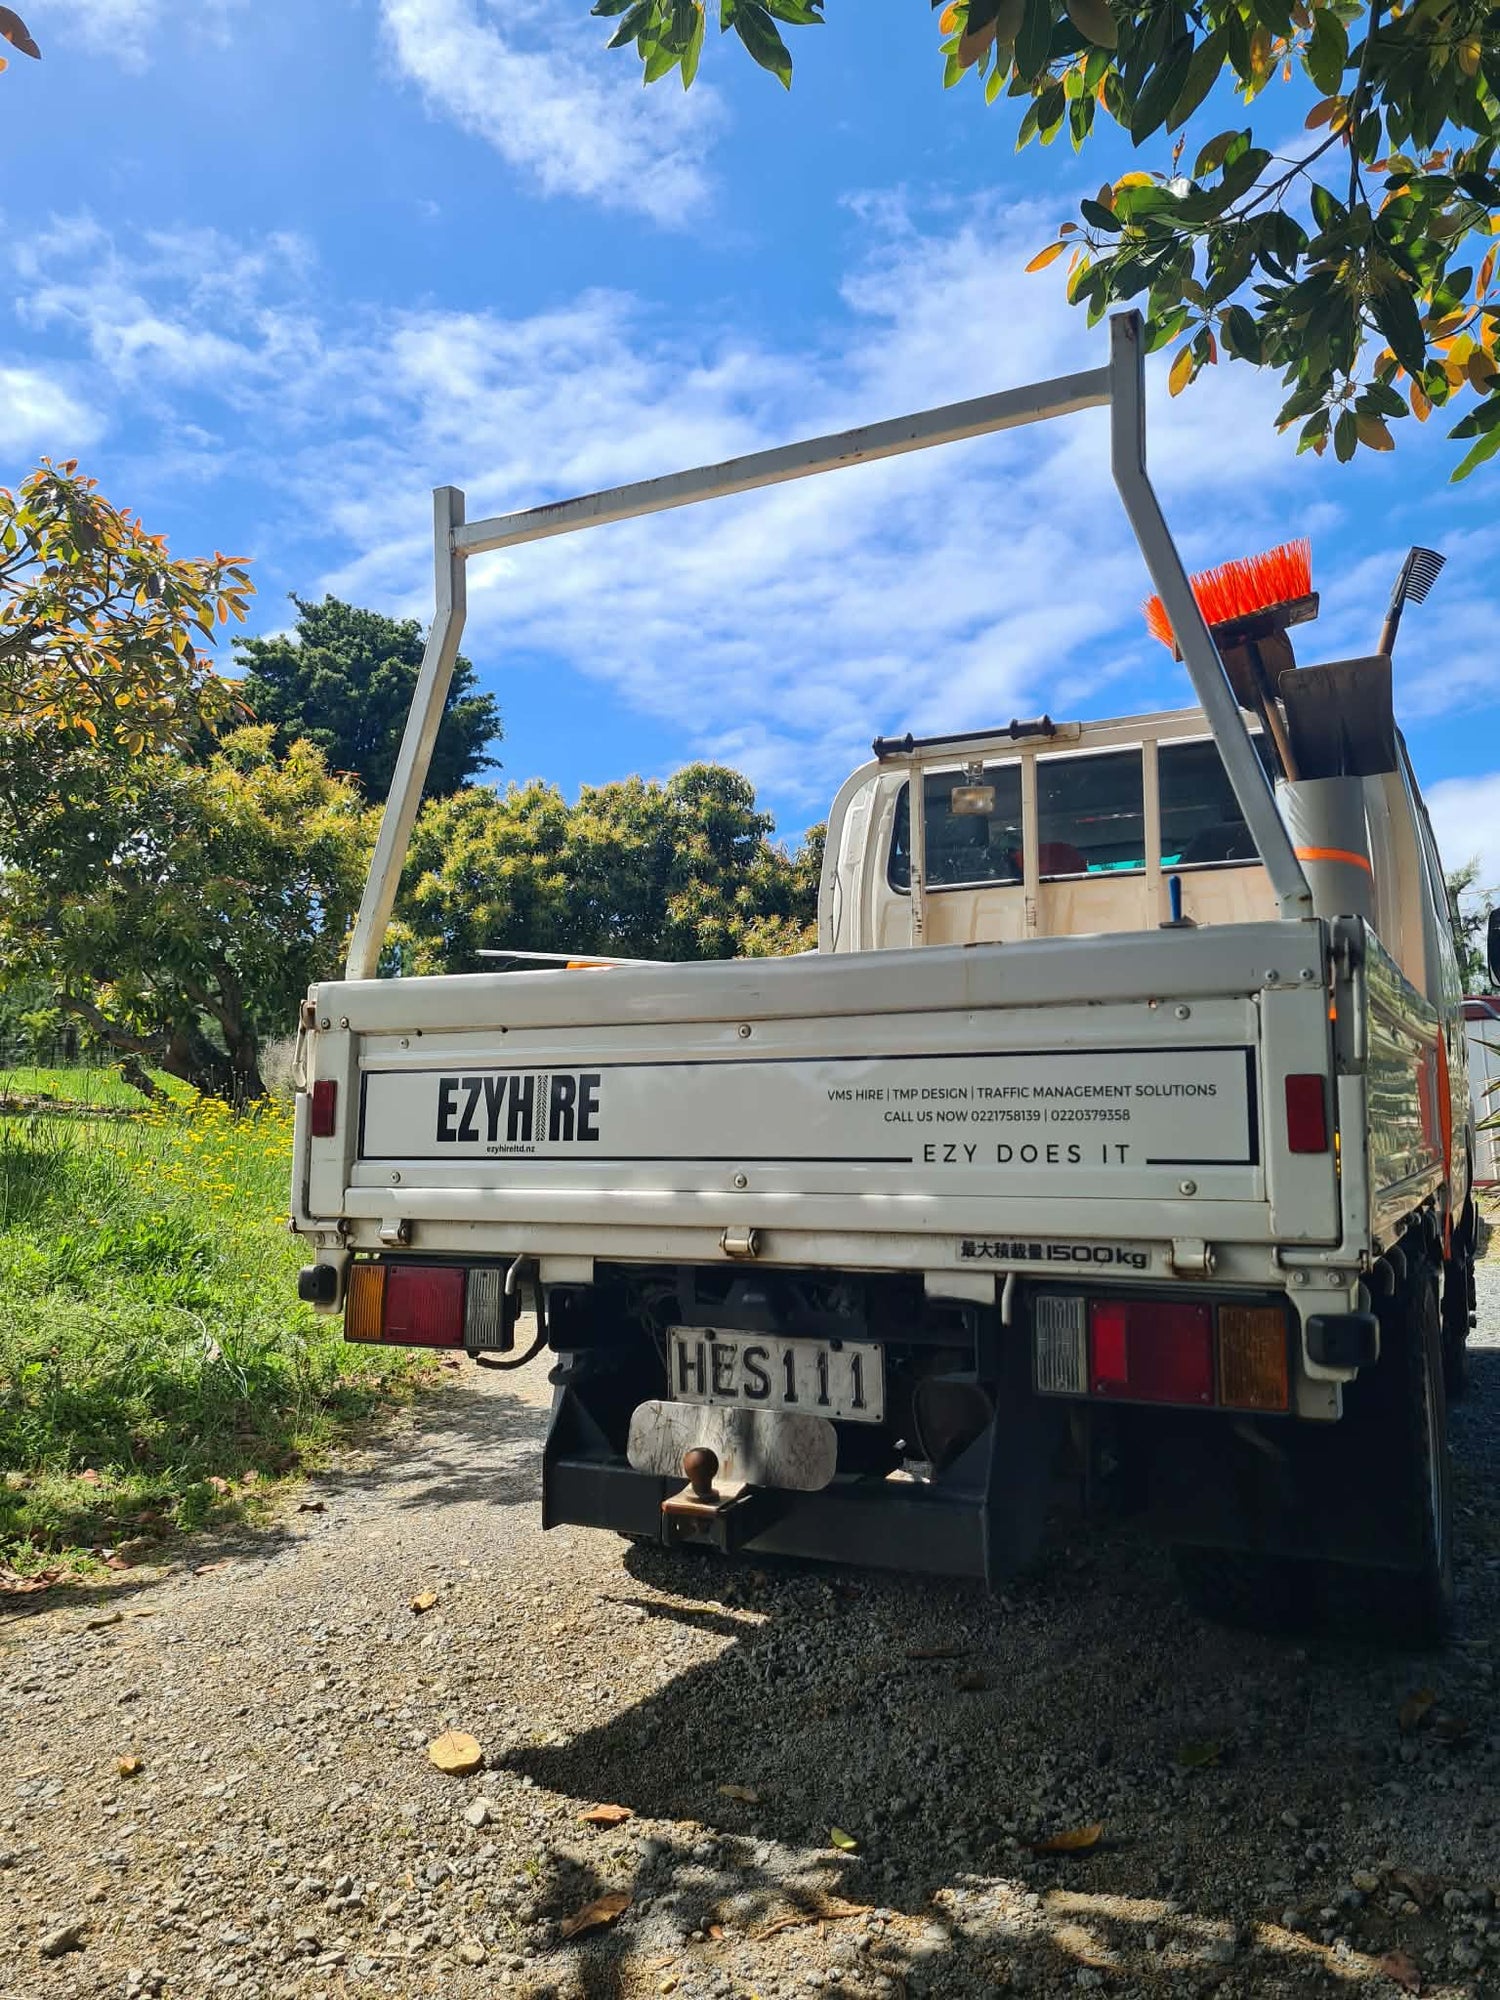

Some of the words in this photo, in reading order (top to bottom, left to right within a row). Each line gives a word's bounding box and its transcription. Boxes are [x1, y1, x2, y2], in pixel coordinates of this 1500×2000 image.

[827, 1090, 852, 1100] VMS
[856, 1089, 884, 1100] HIRE
[893, 1088, 918, 1099] TMP
[922, 1087, 968, 1099] DESIGN
[977, 1086, 1029, 1099] TRAFFIC
[1033, 1085, 1132, 1098] MANAGEMENT
[1135, 1084, 1217, 1096] SOLUTIONS
[436, 1073, 601, 1142] EZYHIRE
[884, 1111, 913, 1122] CALL
[917, 1111, 933, 1122] US
[937, 1110, 968, 1122] NOW
[971, 1109, 1041, 1122] 0221758139
[1051, 1109, 1130, 1121] 0220379358
[924, 1144, 977, 1163] EZY
[997, 1144, 1081, 1164] DOES
[1102, 1144, 1130, 1164] IT
[677, 1341, 868, 1410] HES111
